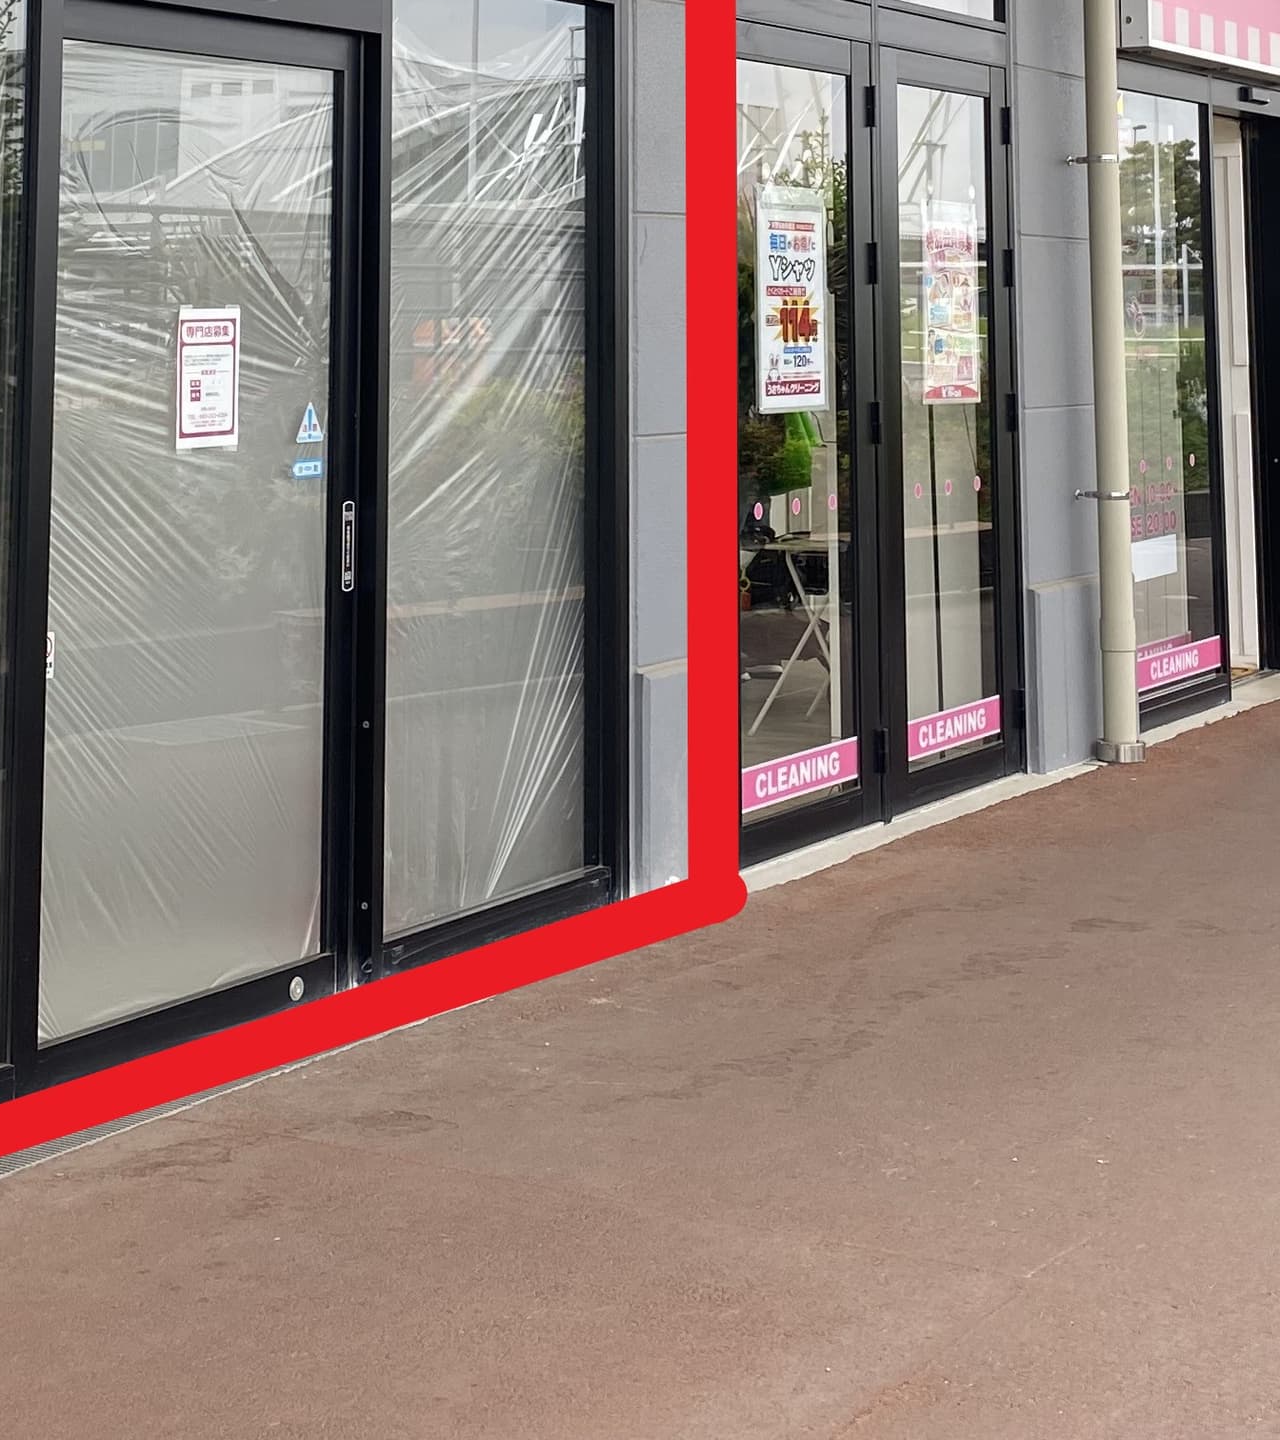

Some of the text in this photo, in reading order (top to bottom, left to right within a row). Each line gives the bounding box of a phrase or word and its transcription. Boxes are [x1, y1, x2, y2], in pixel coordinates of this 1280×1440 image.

[768, 254, 816, 282] Yシャツ
[1150, 648, 1199, 681] CLEANING
[918, 707, 987, 749] CLEANING
[755, 750, 841, 799] CLEANING
